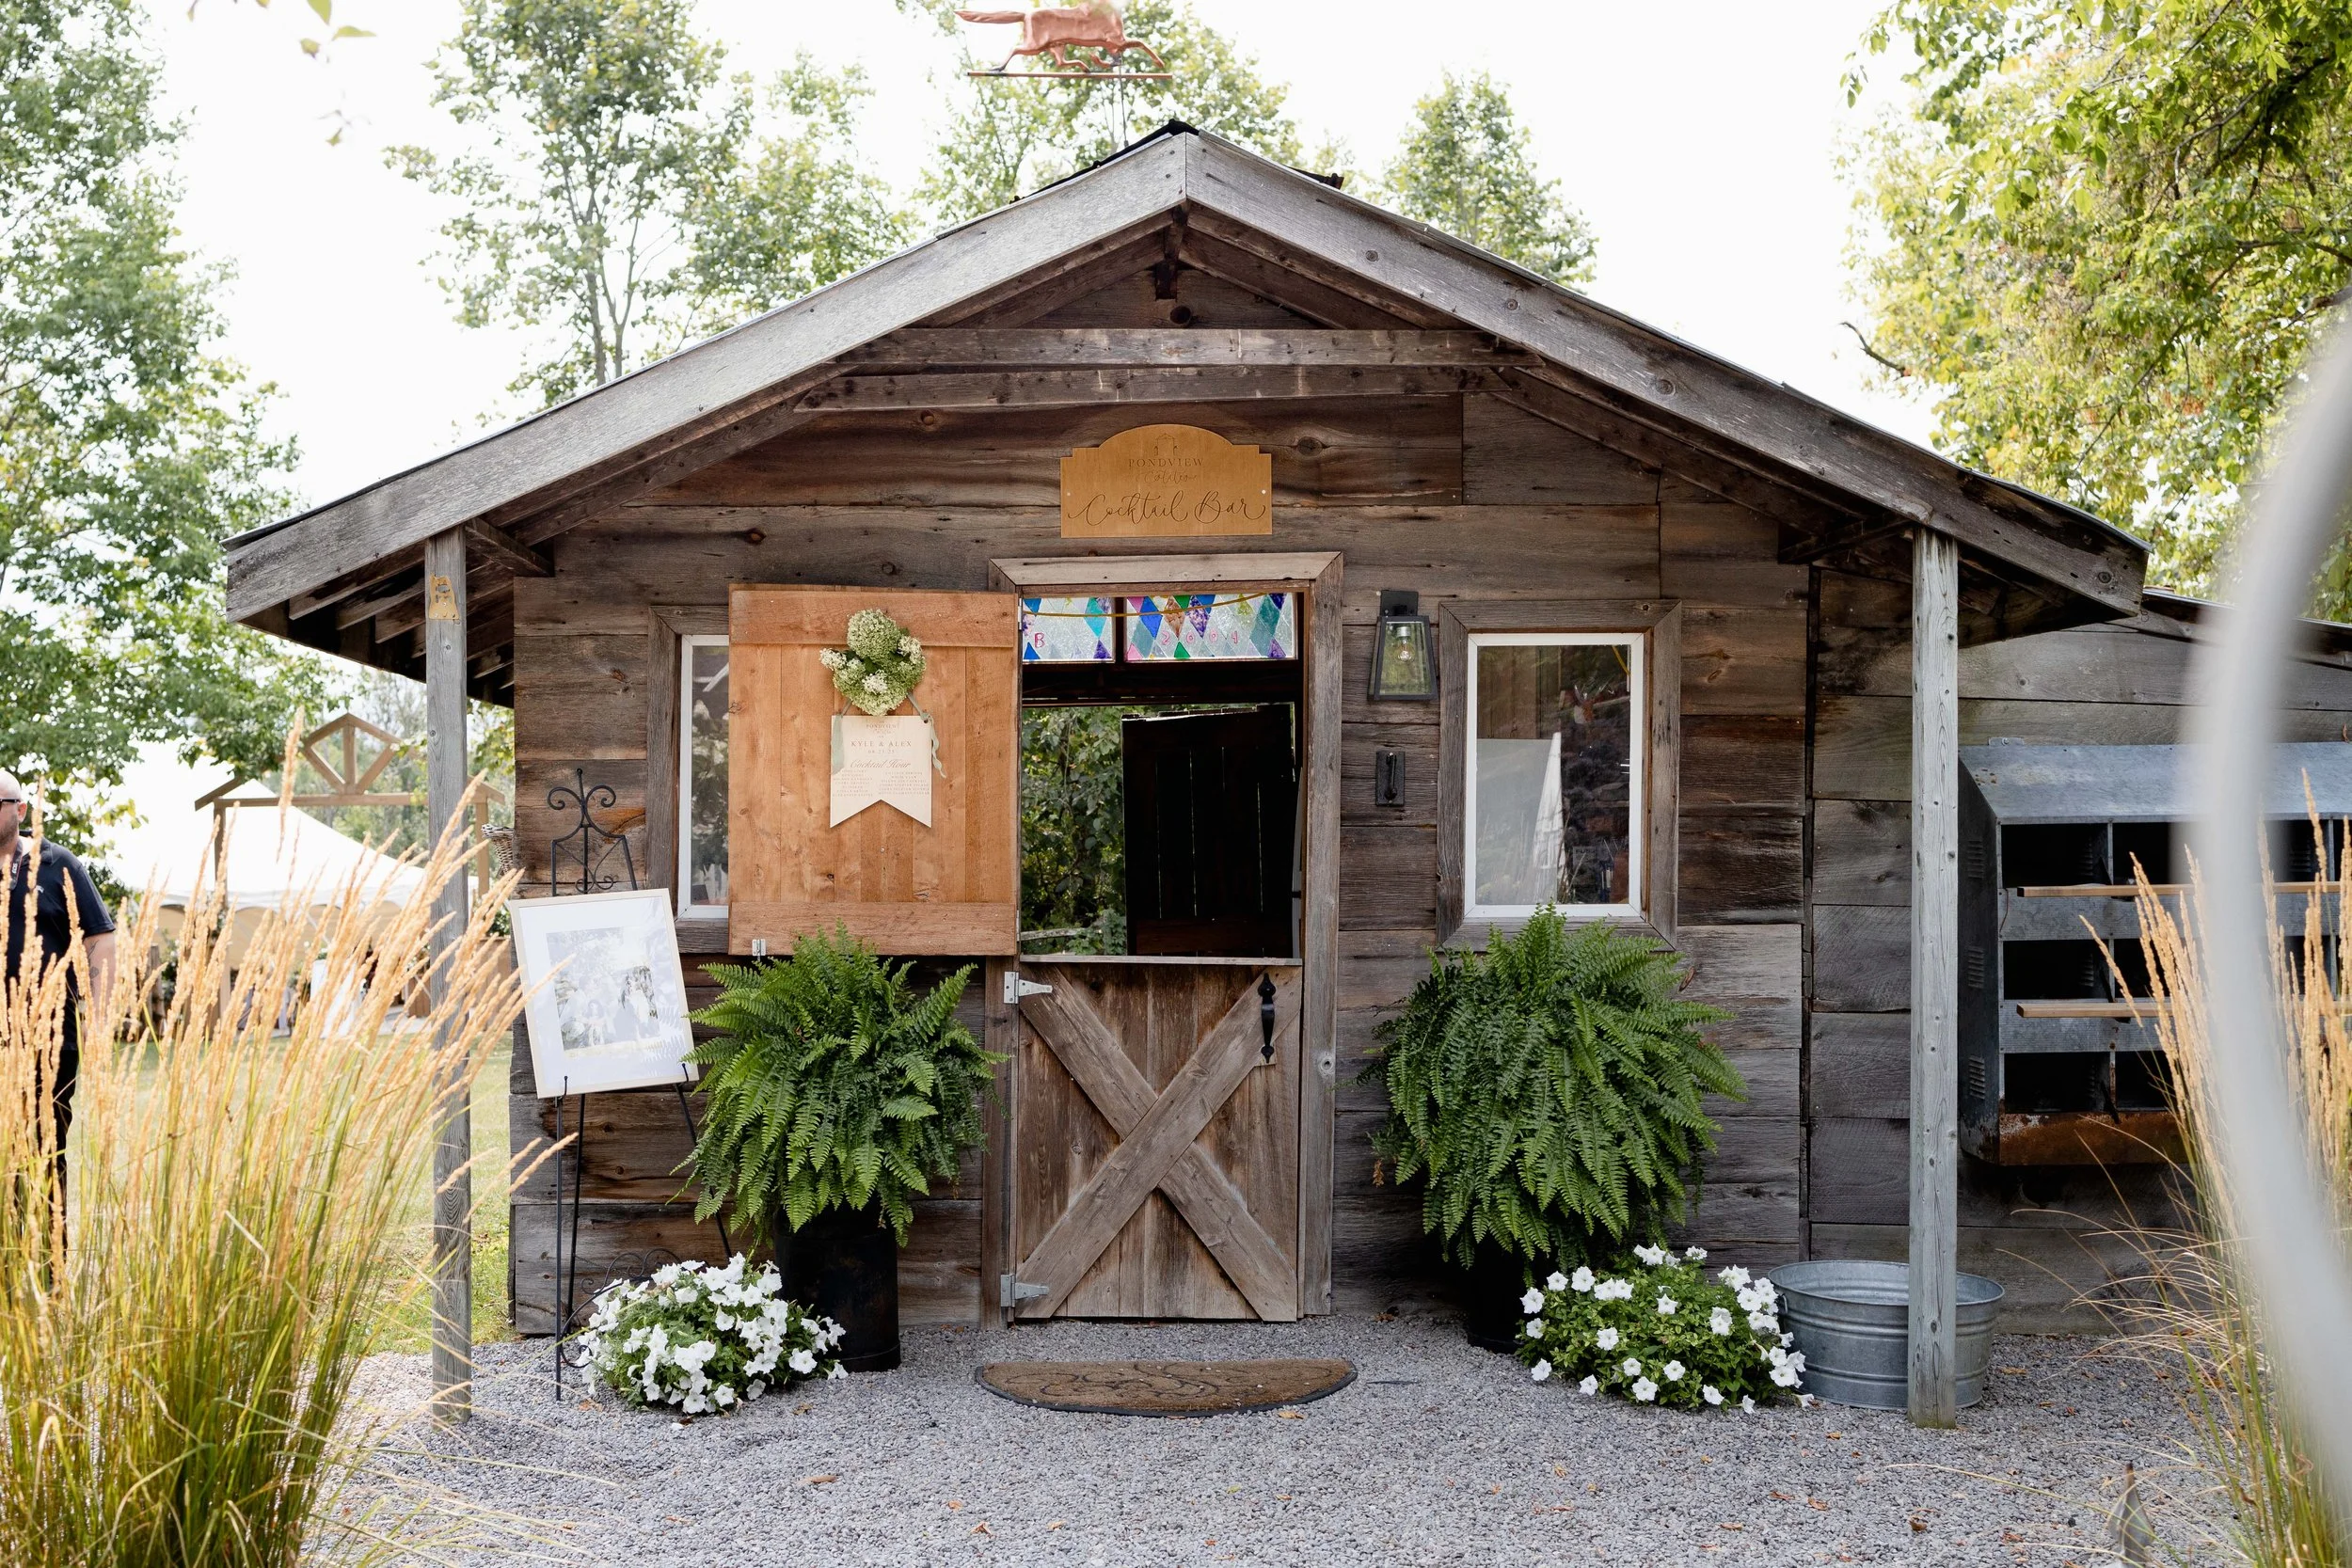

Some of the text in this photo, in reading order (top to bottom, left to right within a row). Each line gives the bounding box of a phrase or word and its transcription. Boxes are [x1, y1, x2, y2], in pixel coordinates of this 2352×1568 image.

[1128, 458, 1203, 467] PONDVIEW
[1067, 489, 1266, 527] Cocktail Bar
[850, 759, 912, 768] Cocktail Hour
